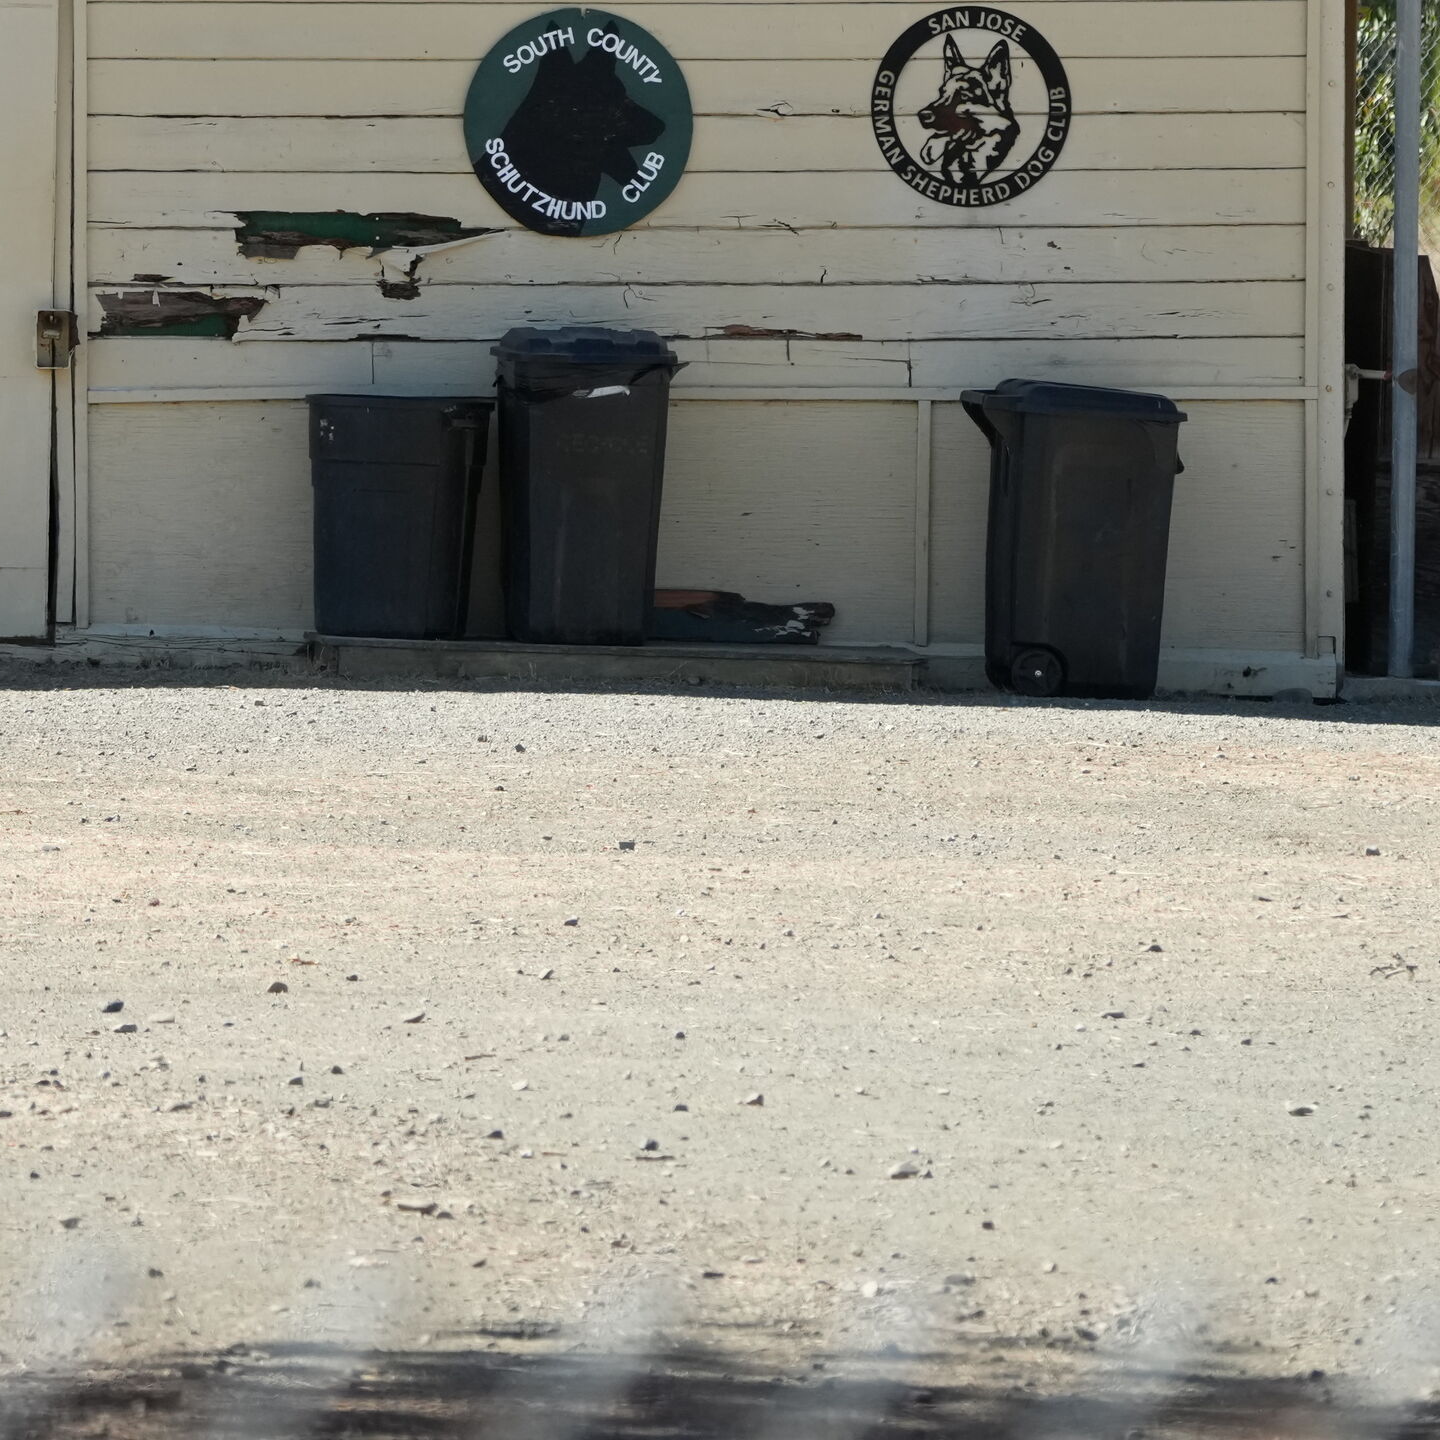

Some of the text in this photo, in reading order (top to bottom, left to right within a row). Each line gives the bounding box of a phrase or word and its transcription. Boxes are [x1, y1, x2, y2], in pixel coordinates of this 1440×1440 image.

[503, 27, 662, 84] SOUTH COUNTY
[928, 10, 1027, 41] SAN JOSE
[874, 70, 1067, 205] GERMAN SHEPHERD DOG CLUB
[485, 137, 665, 220] SCHUTZHUND CLUB
